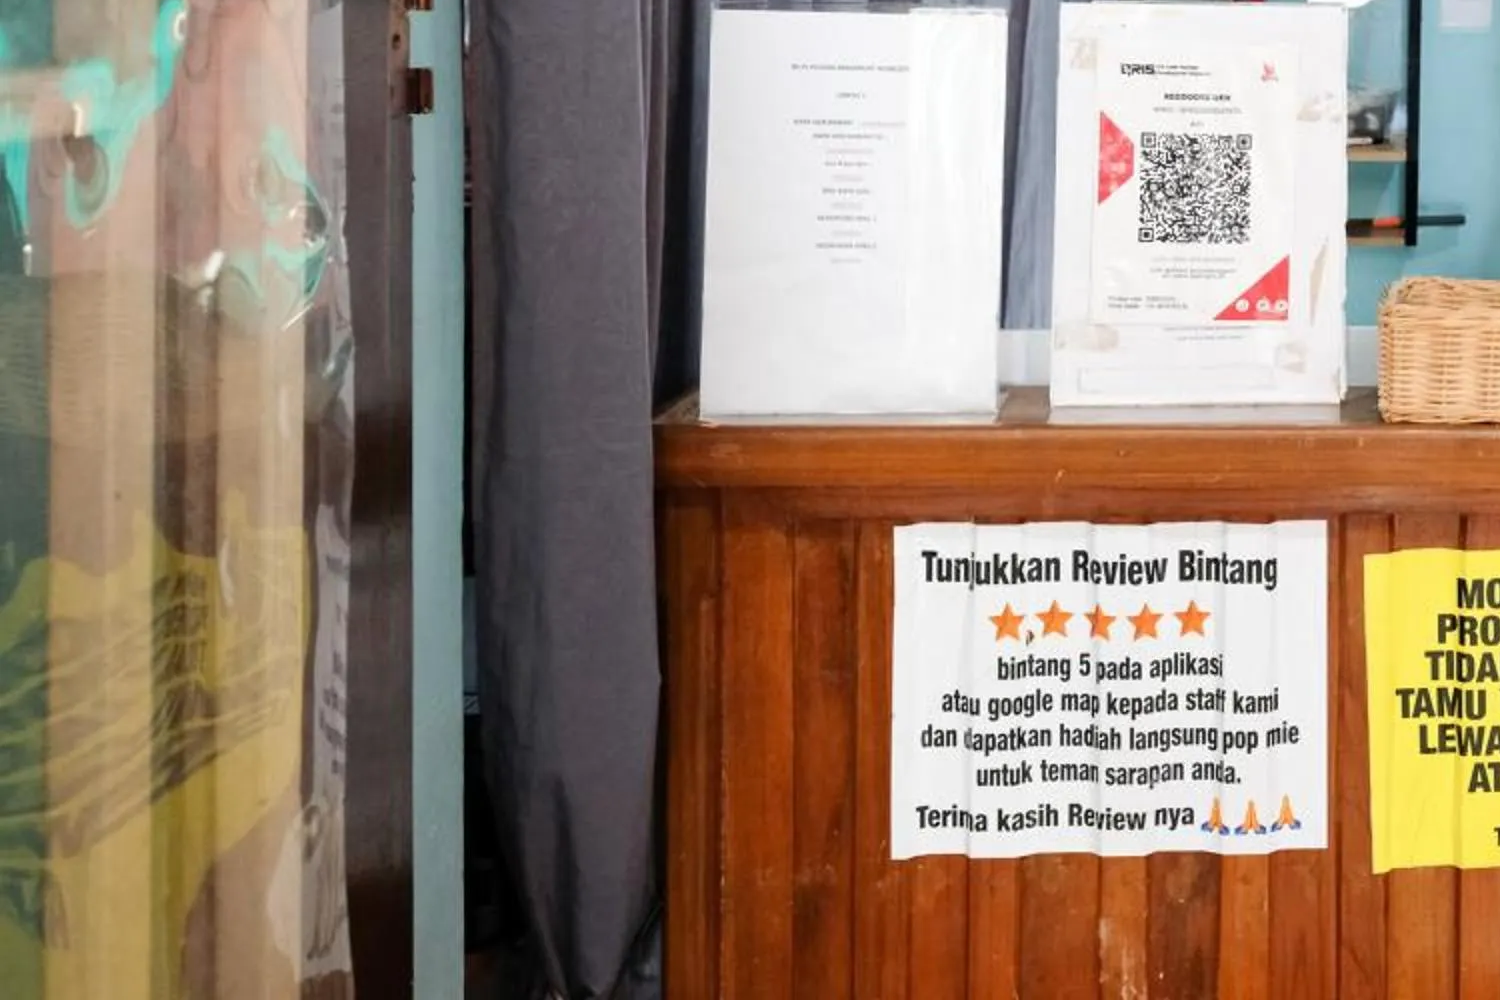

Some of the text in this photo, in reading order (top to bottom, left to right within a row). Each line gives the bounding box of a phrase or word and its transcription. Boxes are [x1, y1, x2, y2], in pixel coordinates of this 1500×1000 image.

[921, 549, 1278, 591] Tunjukkan Review Bintang
[997, 652, 1224, 684] bintang 5 pada aplikasi
[941, 687, 1279, 721] atau google map kepada staff kami
[1396, 688, 1487, 721] TAMU
[920, 724, 958, 748] dan
[1059, 723, 1121, 750] hadiah
[1129, 726, 1218, 752] langsung
[1223, 730, 1259, 754] pop
[1266, 721, 1300, 748] mie
[976, 759, 1242, 789] untuk teman sarapan anda.
[997, 804, 1059, 832] kasih
[1068, 803, 1147, 831] Review
[1154, 807, 1196, 831] nya
